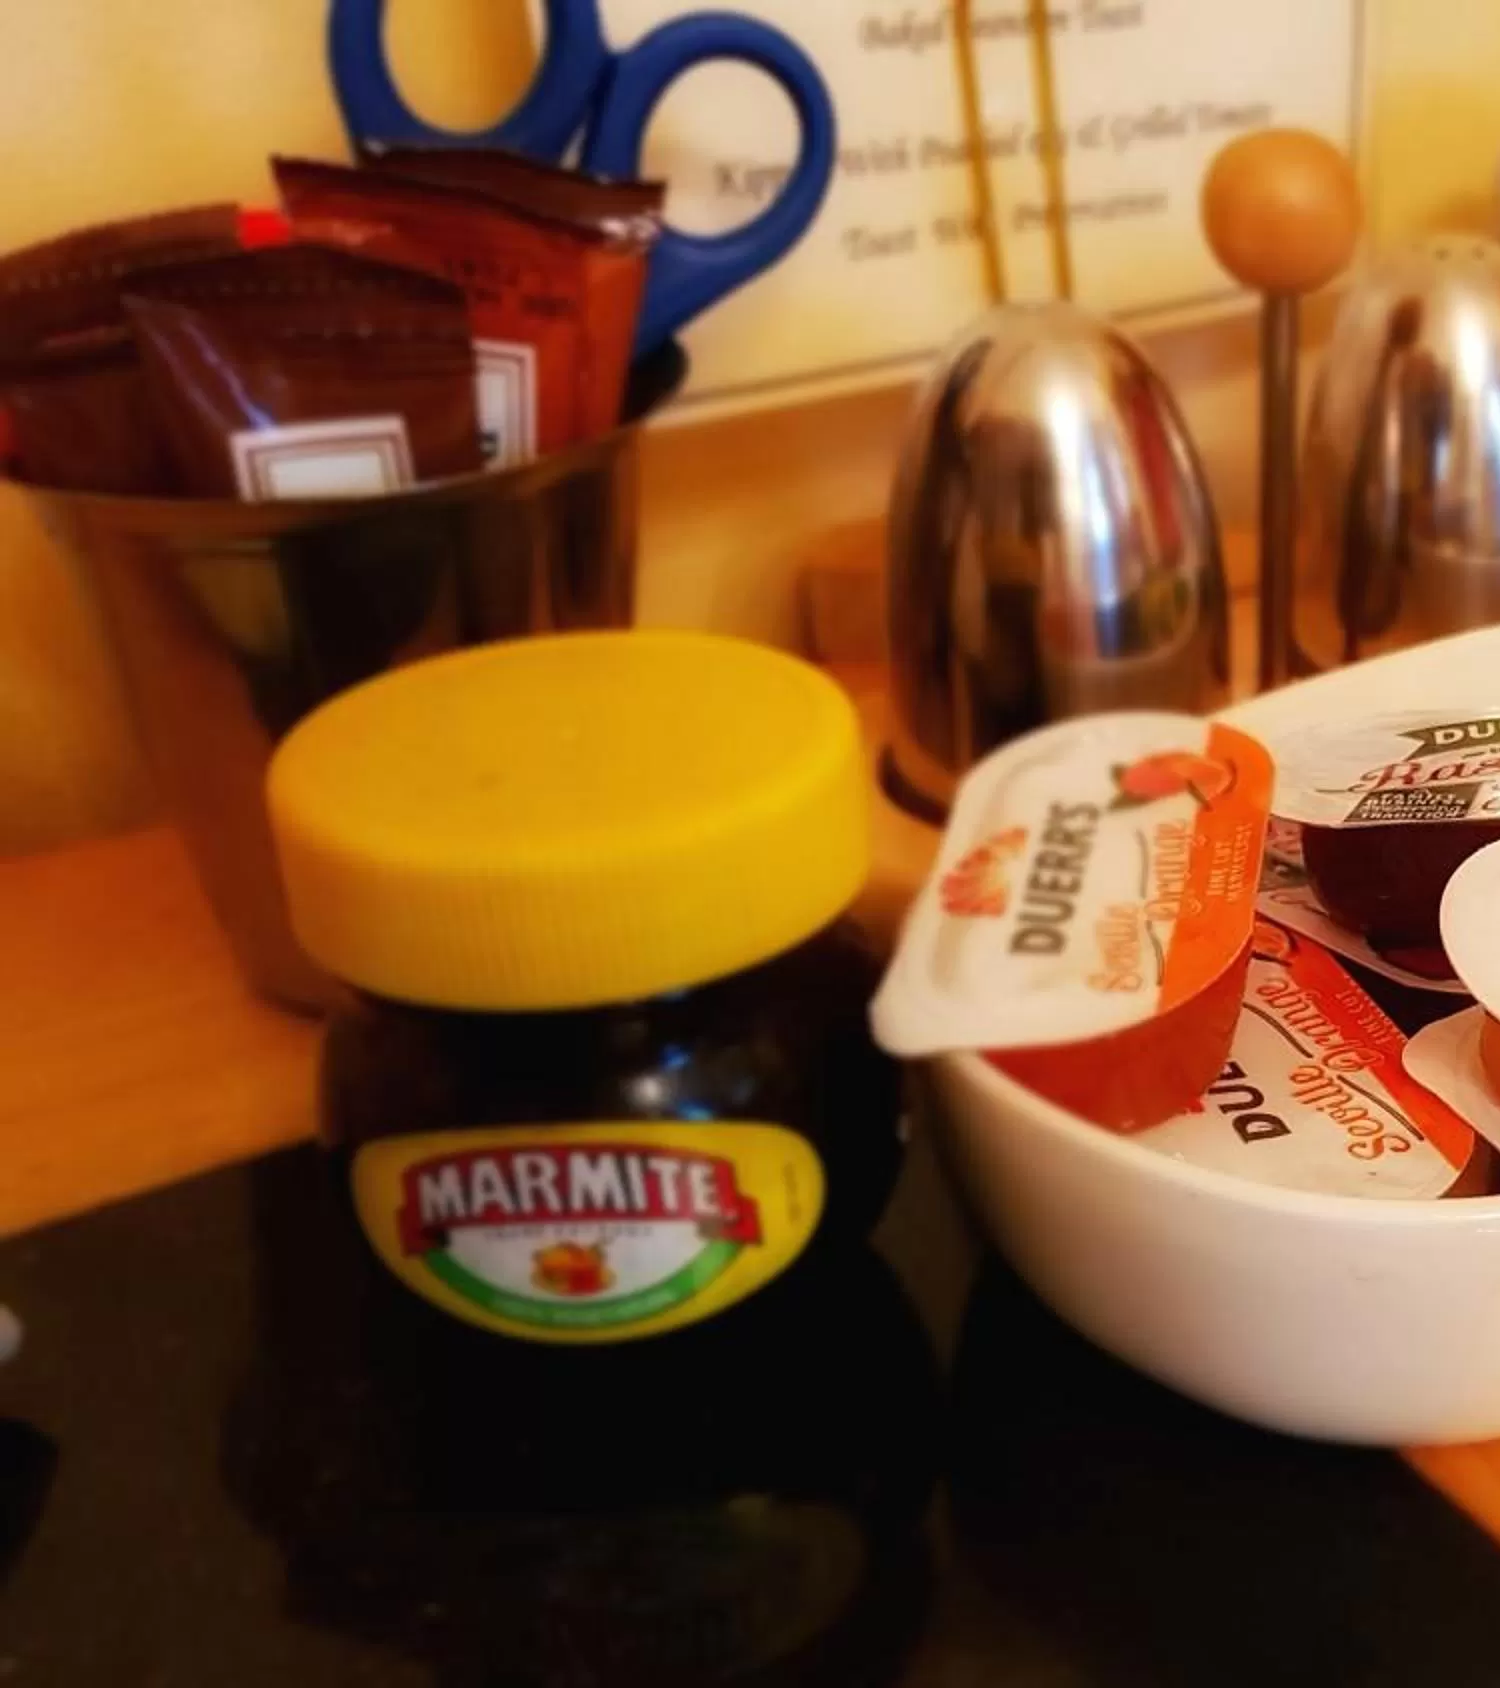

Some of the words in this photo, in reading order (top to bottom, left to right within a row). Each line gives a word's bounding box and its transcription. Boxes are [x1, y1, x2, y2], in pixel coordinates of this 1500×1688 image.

[1256, 976, 1385, 1073] Orange
[1289, 1064, 1412, 1161] Seville
[417, 1151, 724, 1226] MARMITE
